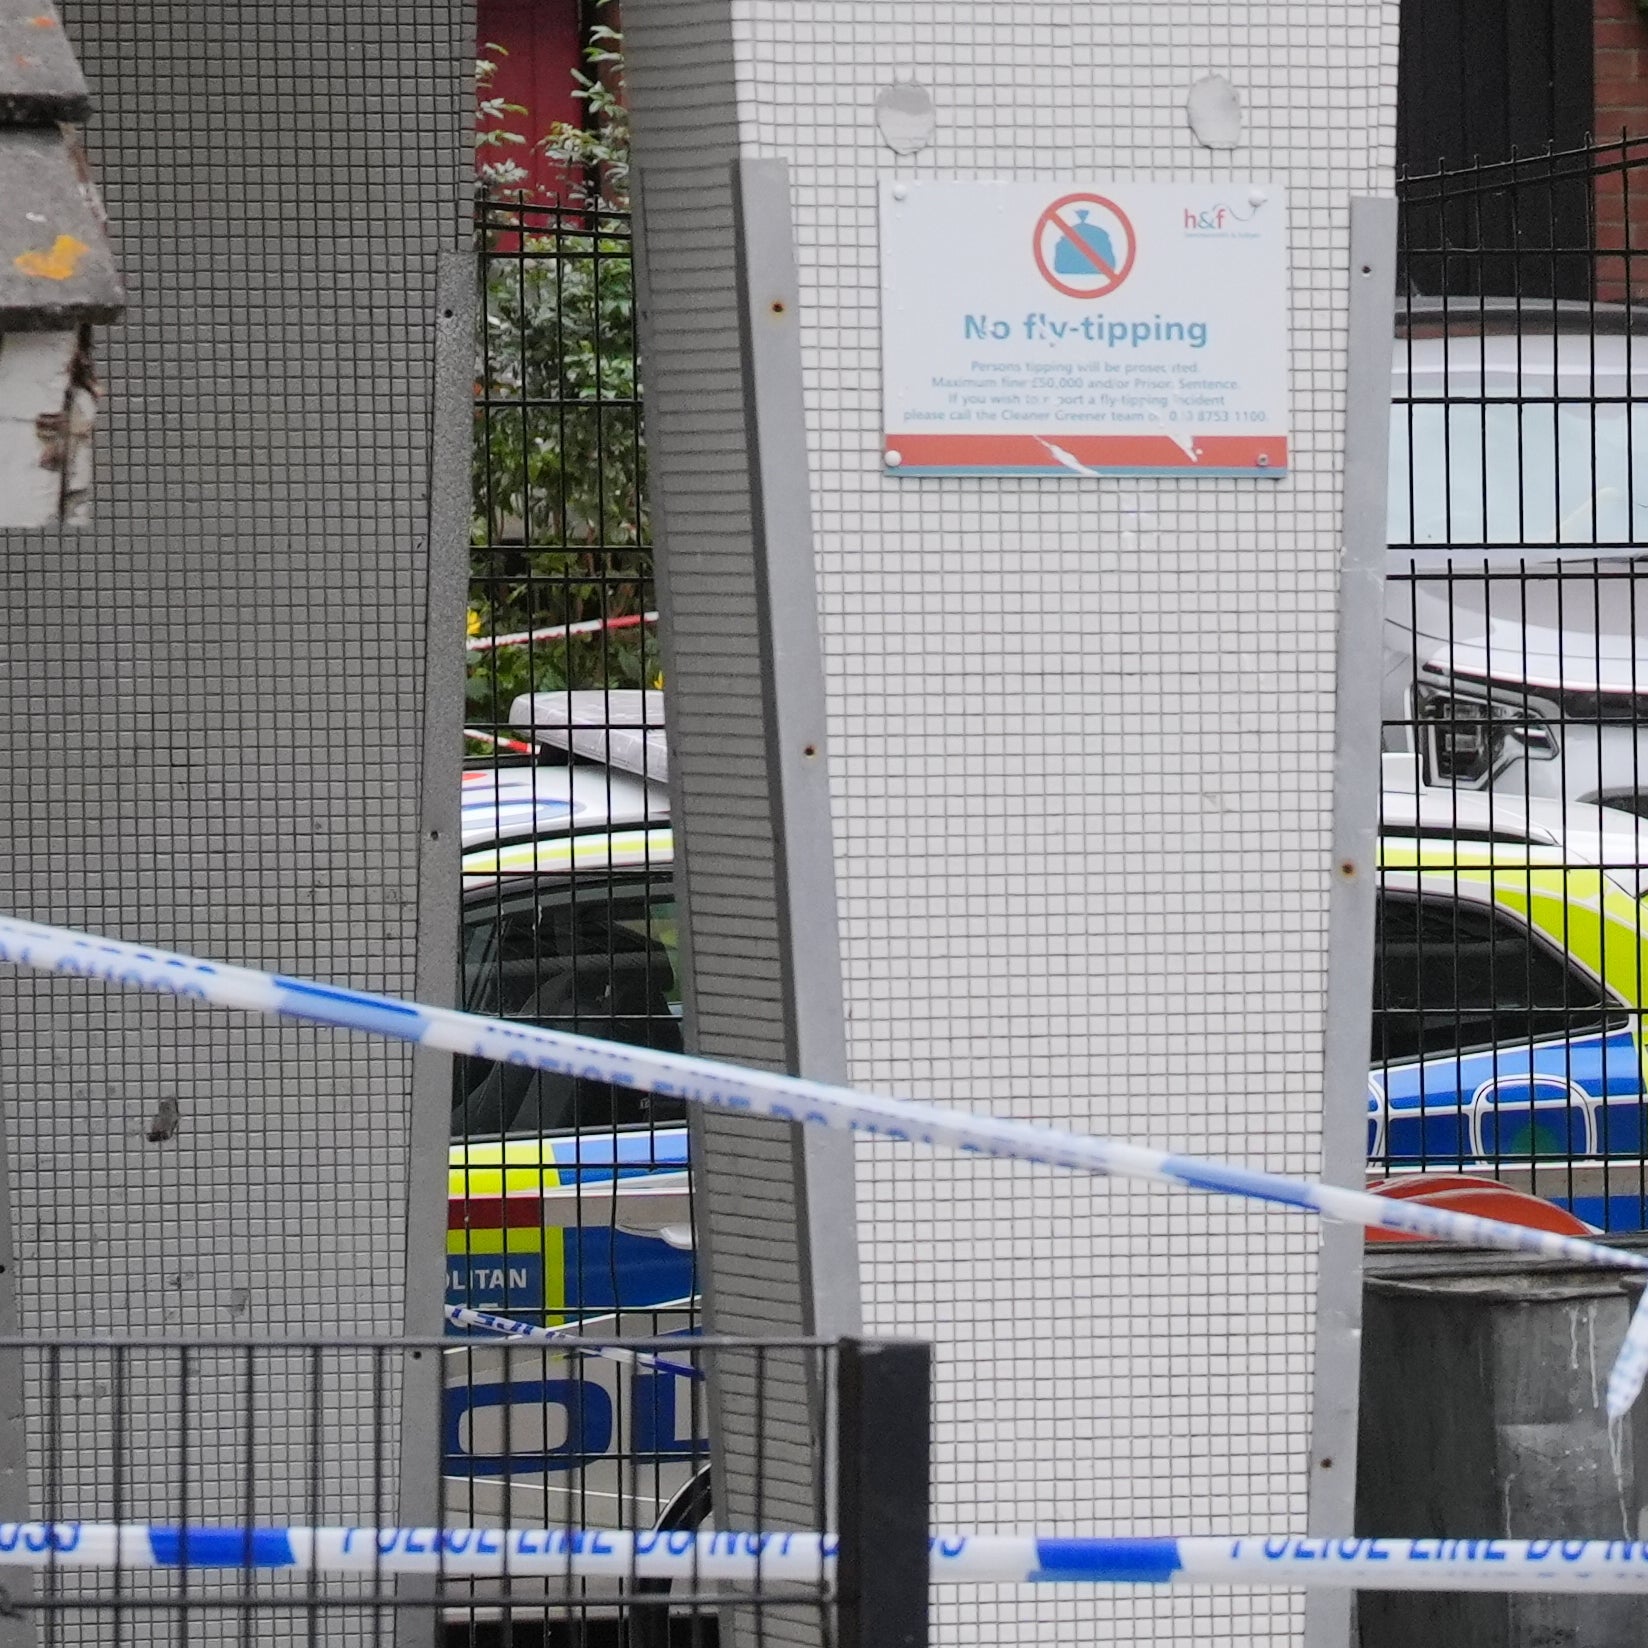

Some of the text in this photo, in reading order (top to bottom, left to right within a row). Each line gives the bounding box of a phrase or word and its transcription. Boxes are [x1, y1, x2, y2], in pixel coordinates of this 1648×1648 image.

[1184, 207, 1226, 229] h&f
[963, 312, 1207, 348] No fly-tipping
[971, 361, 1022, 372] Persons
[1025, 361, 1073, 375] tipping
[1077, 362, 1101, 372] will
[1104, 362, 1120, 373] be
[932, 377, 997, 388] Maximum
[1001, 377, 1027, 388] fine
[1031, 377, 1084, 389] £50,000
[1088, 378, 1129, 389] and/or
[949, 394, 958, 404] If
[963, 396, 987, 407] you
[991, 394, 1020, 404] wish
[1025, 395, 1039, 404] to
[1043, 396, 1083, 407] rport
[1088, 397, 1096, 405] a
[1101, 395, 1168, 407] fly-tipping
[903, 409, 946, 423] please
[950, 409, 971, 420] call
[976, 410, 996, 420] the
[1001, 410, 1050, 420] Cleaner
[1054, 410, 1106, 421] Greener
[1111, 411, 1144, 421] team
[446, 1268, 527, 1290] LITAN
